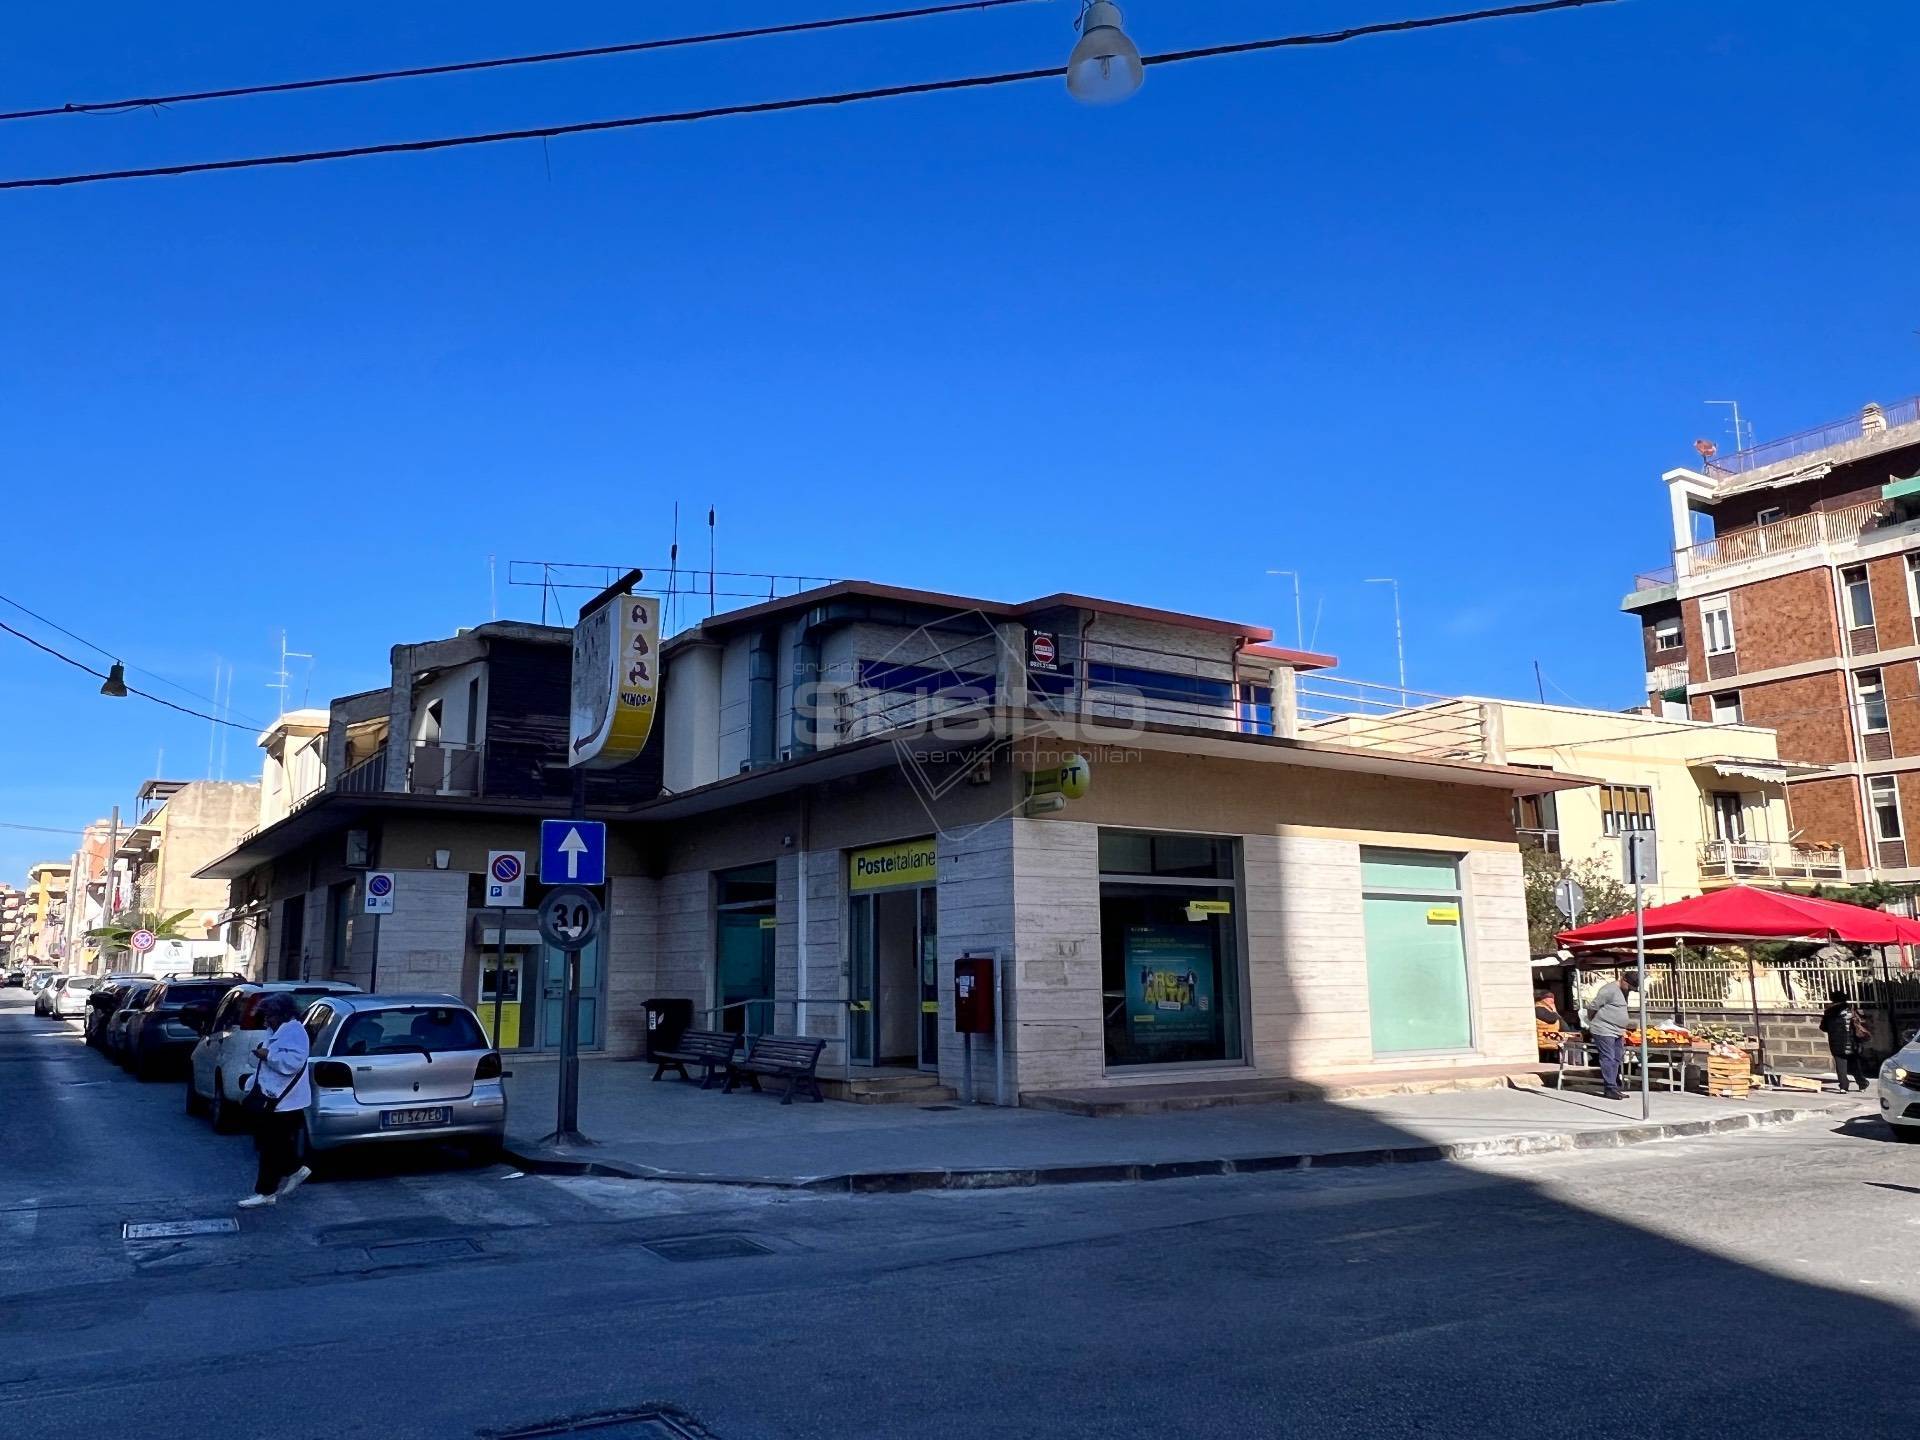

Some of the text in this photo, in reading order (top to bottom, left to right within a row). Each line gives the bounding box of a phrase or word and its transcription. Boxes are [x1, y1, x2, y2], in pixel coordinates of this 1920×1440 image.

[1060, 766, 1081, 788] PT
[857, 849, 936, 876] Posteitaliane
[552, 903, 589, 936] 30
